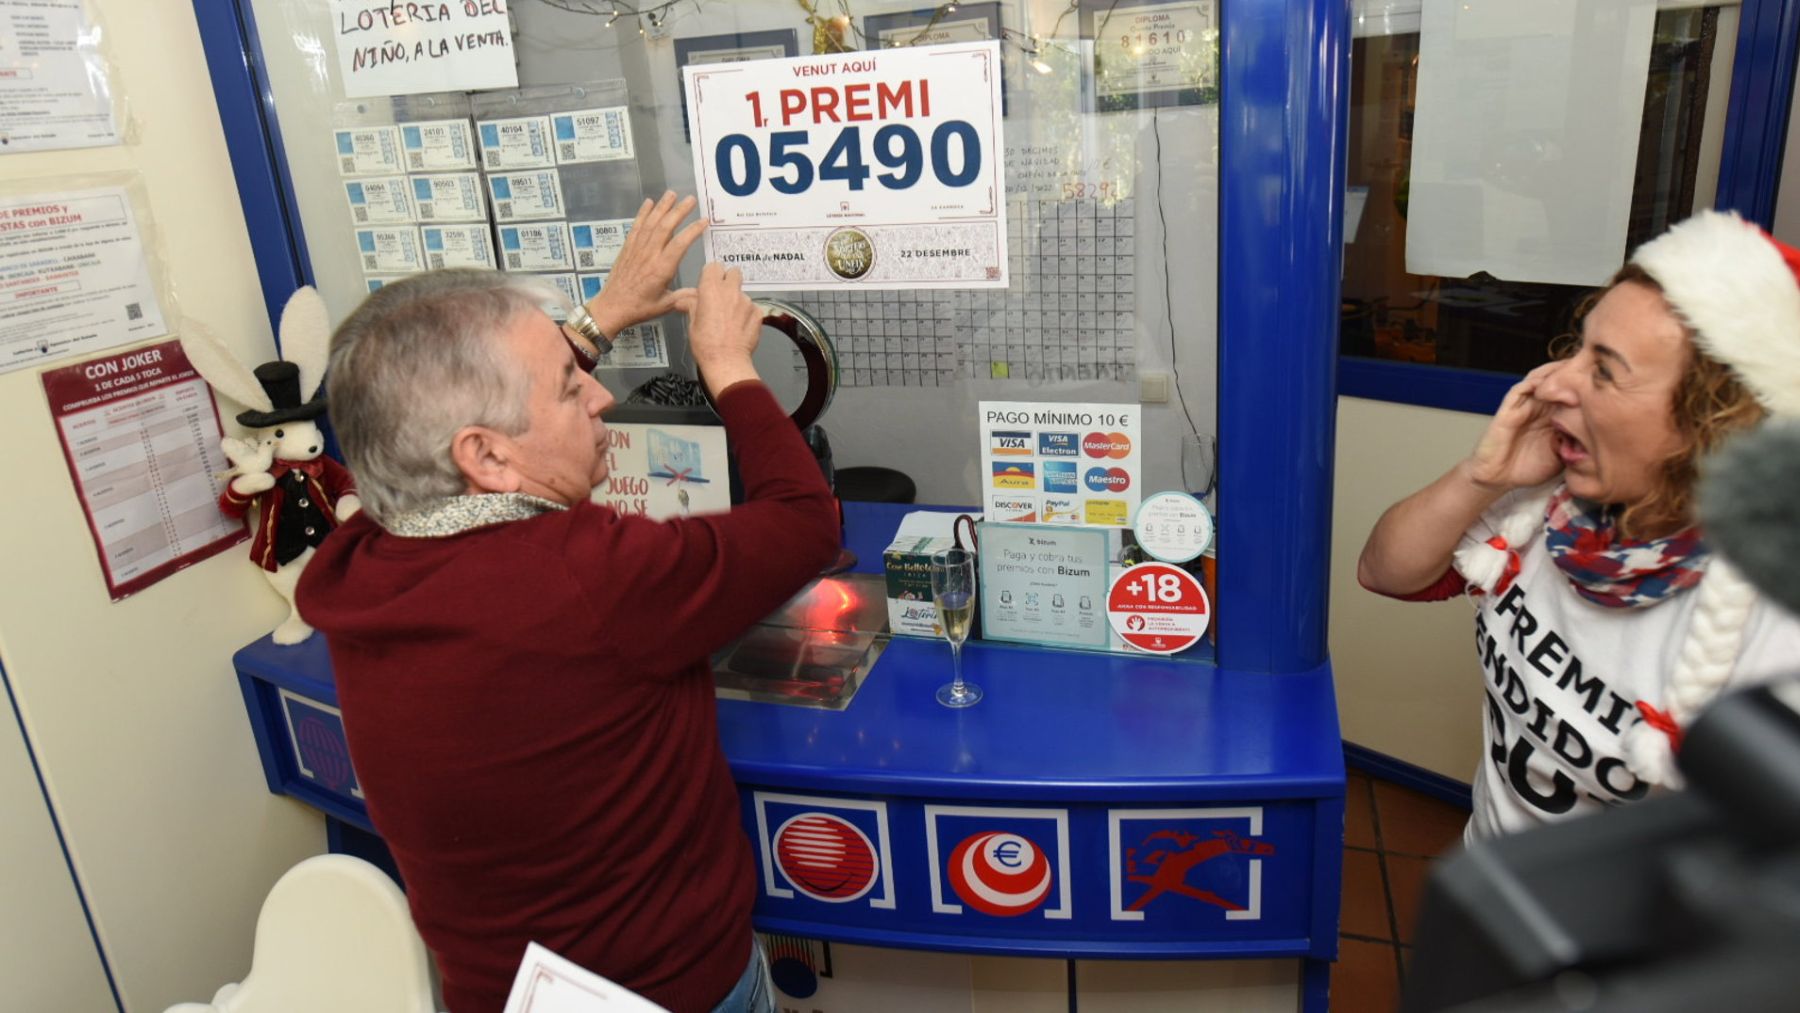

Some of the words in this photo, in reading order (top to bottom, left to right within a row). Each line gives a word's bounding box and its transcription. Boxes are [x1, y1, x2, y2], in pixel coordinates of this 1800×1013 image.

[341, 4, 451, 34] LOTERIA
[463, 0, 506, 17] DEL
[1135, 14, 1170, 24] DIPLOMA
[415, 46, 423, 60] A
[429, 38, 450, 58] LA
[793, 63, 837, 77] VENUT
[842, 57, 876, 74] AQUÍ
[780, 79, 930, 126] PREMI
[714, 119, 982, 197] 05490
[12, 204, 60, 218] PREMIOS
[60, 205, 68, 214] y
[28, 219, 47, 229] con
[49, 214, 82, 226] BIZUM
[773, 253, 805, 261] NADAL
[900, 250, 912, 258] 22
[915, 249, 971, 257] DESEMBRE
[15, 286, 58, 299] IMPORTANTE
[85, 361, 118, 379] CON
[121, 349, 162, 371] JOKER
[101, 380, 113, 390] DE
[114, 374, 135, 387] CADA
[142, 367, 162, 379] TOCA
[113, 386, 138, 398] PREMIOS
[987, 411, 1030, 424] PAGO
[1034, 410, 1093, 426] MÍNIMO
[1098, 415, 1115, 426] 10
[1119, 415, 1129, 427] €
[607, 429, 630, 449] ON
[1000, 438, 1025, 449] VISA
[1048, 435, 1068, 443] VISA
[1084, 442, 1131, 450] MasterCard
[1089, 475, 1126, 485] Maestro
[995, 502, 1033, 510] DISCOVER
[1046, 500, 1070, 508] PayPal
[1003, 549, 1027, 561] Paga
[1058, 566, 1090, 577] Bizum
[1126, 574, 1182, 602] +18
